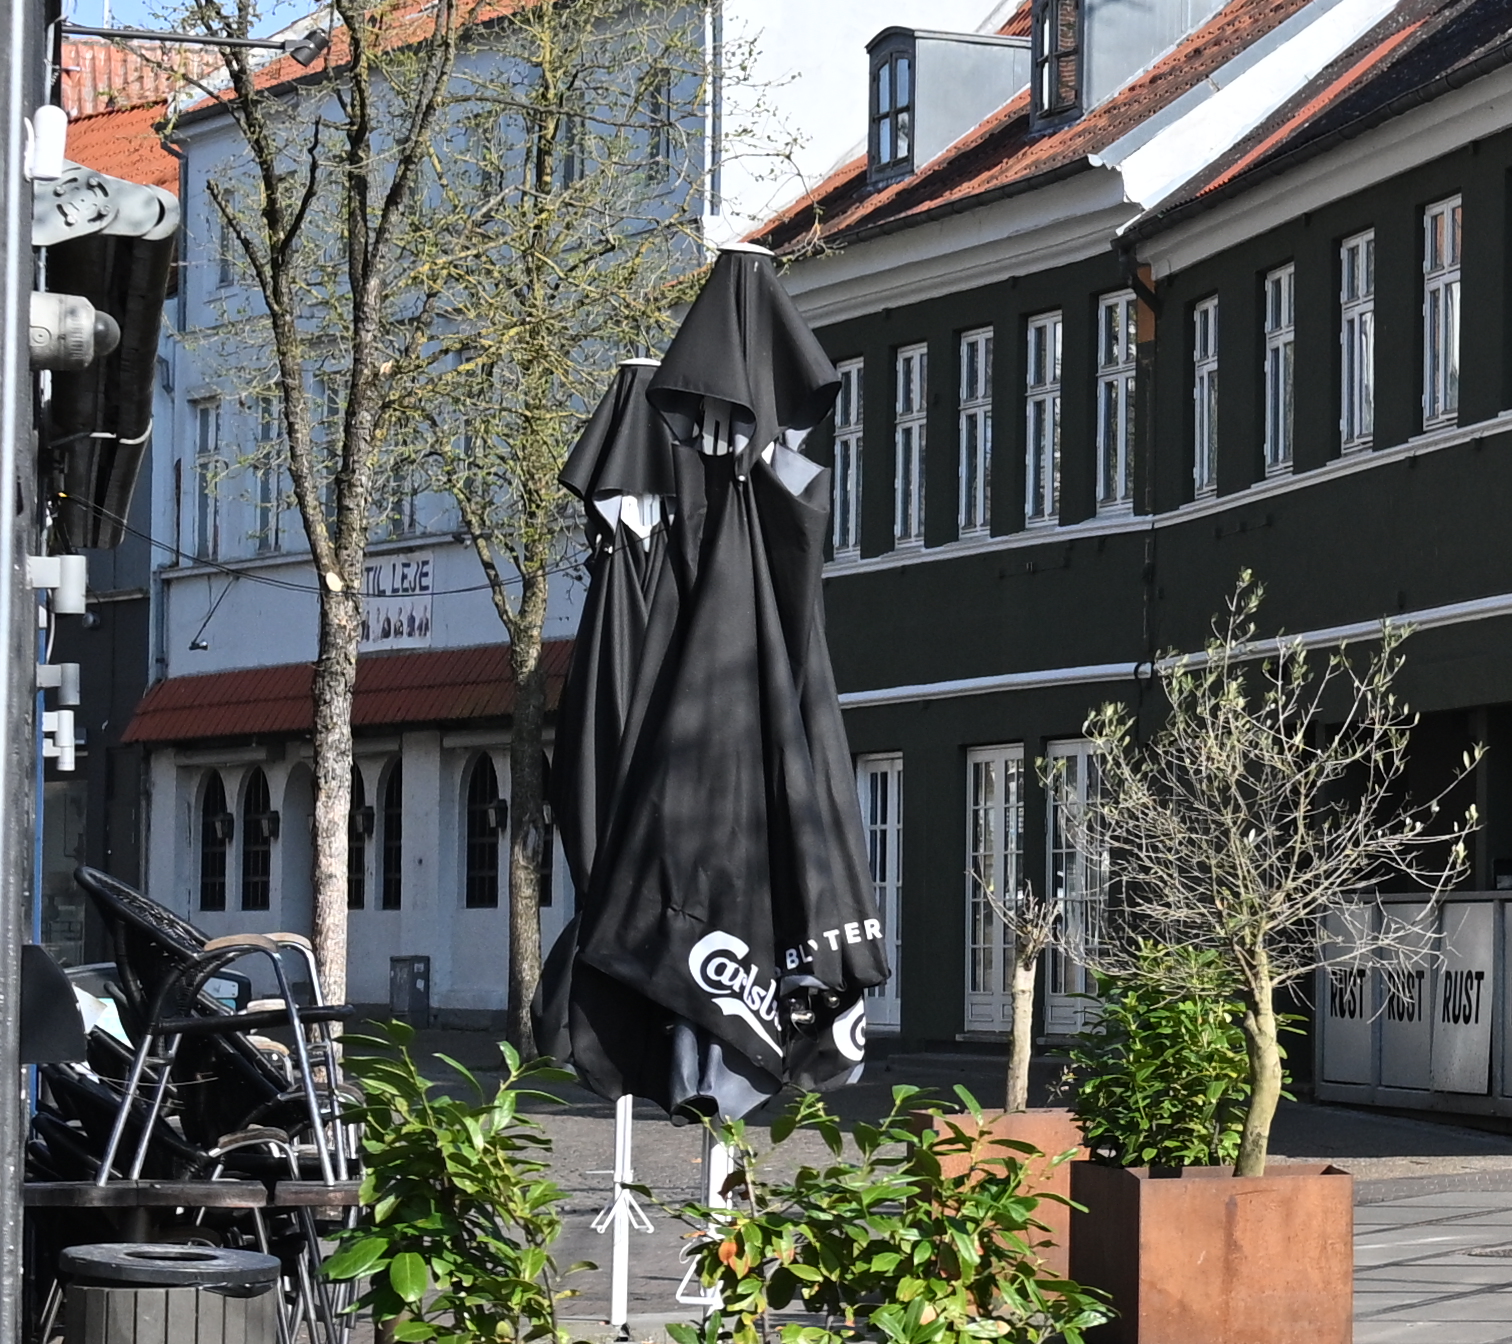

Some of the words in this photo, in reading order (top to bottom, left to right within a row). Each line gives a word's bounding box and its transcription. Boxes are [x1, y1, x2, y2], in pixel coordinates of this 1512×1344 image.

[364, 564, 387, 596] TIL
[391, 559, 430, 594] LEJE
[1330, 968, 1367, 1020] RUST
[1387, 969, 1425, 1023] RUST
[1441, 969, 1485, 1025] RUST
